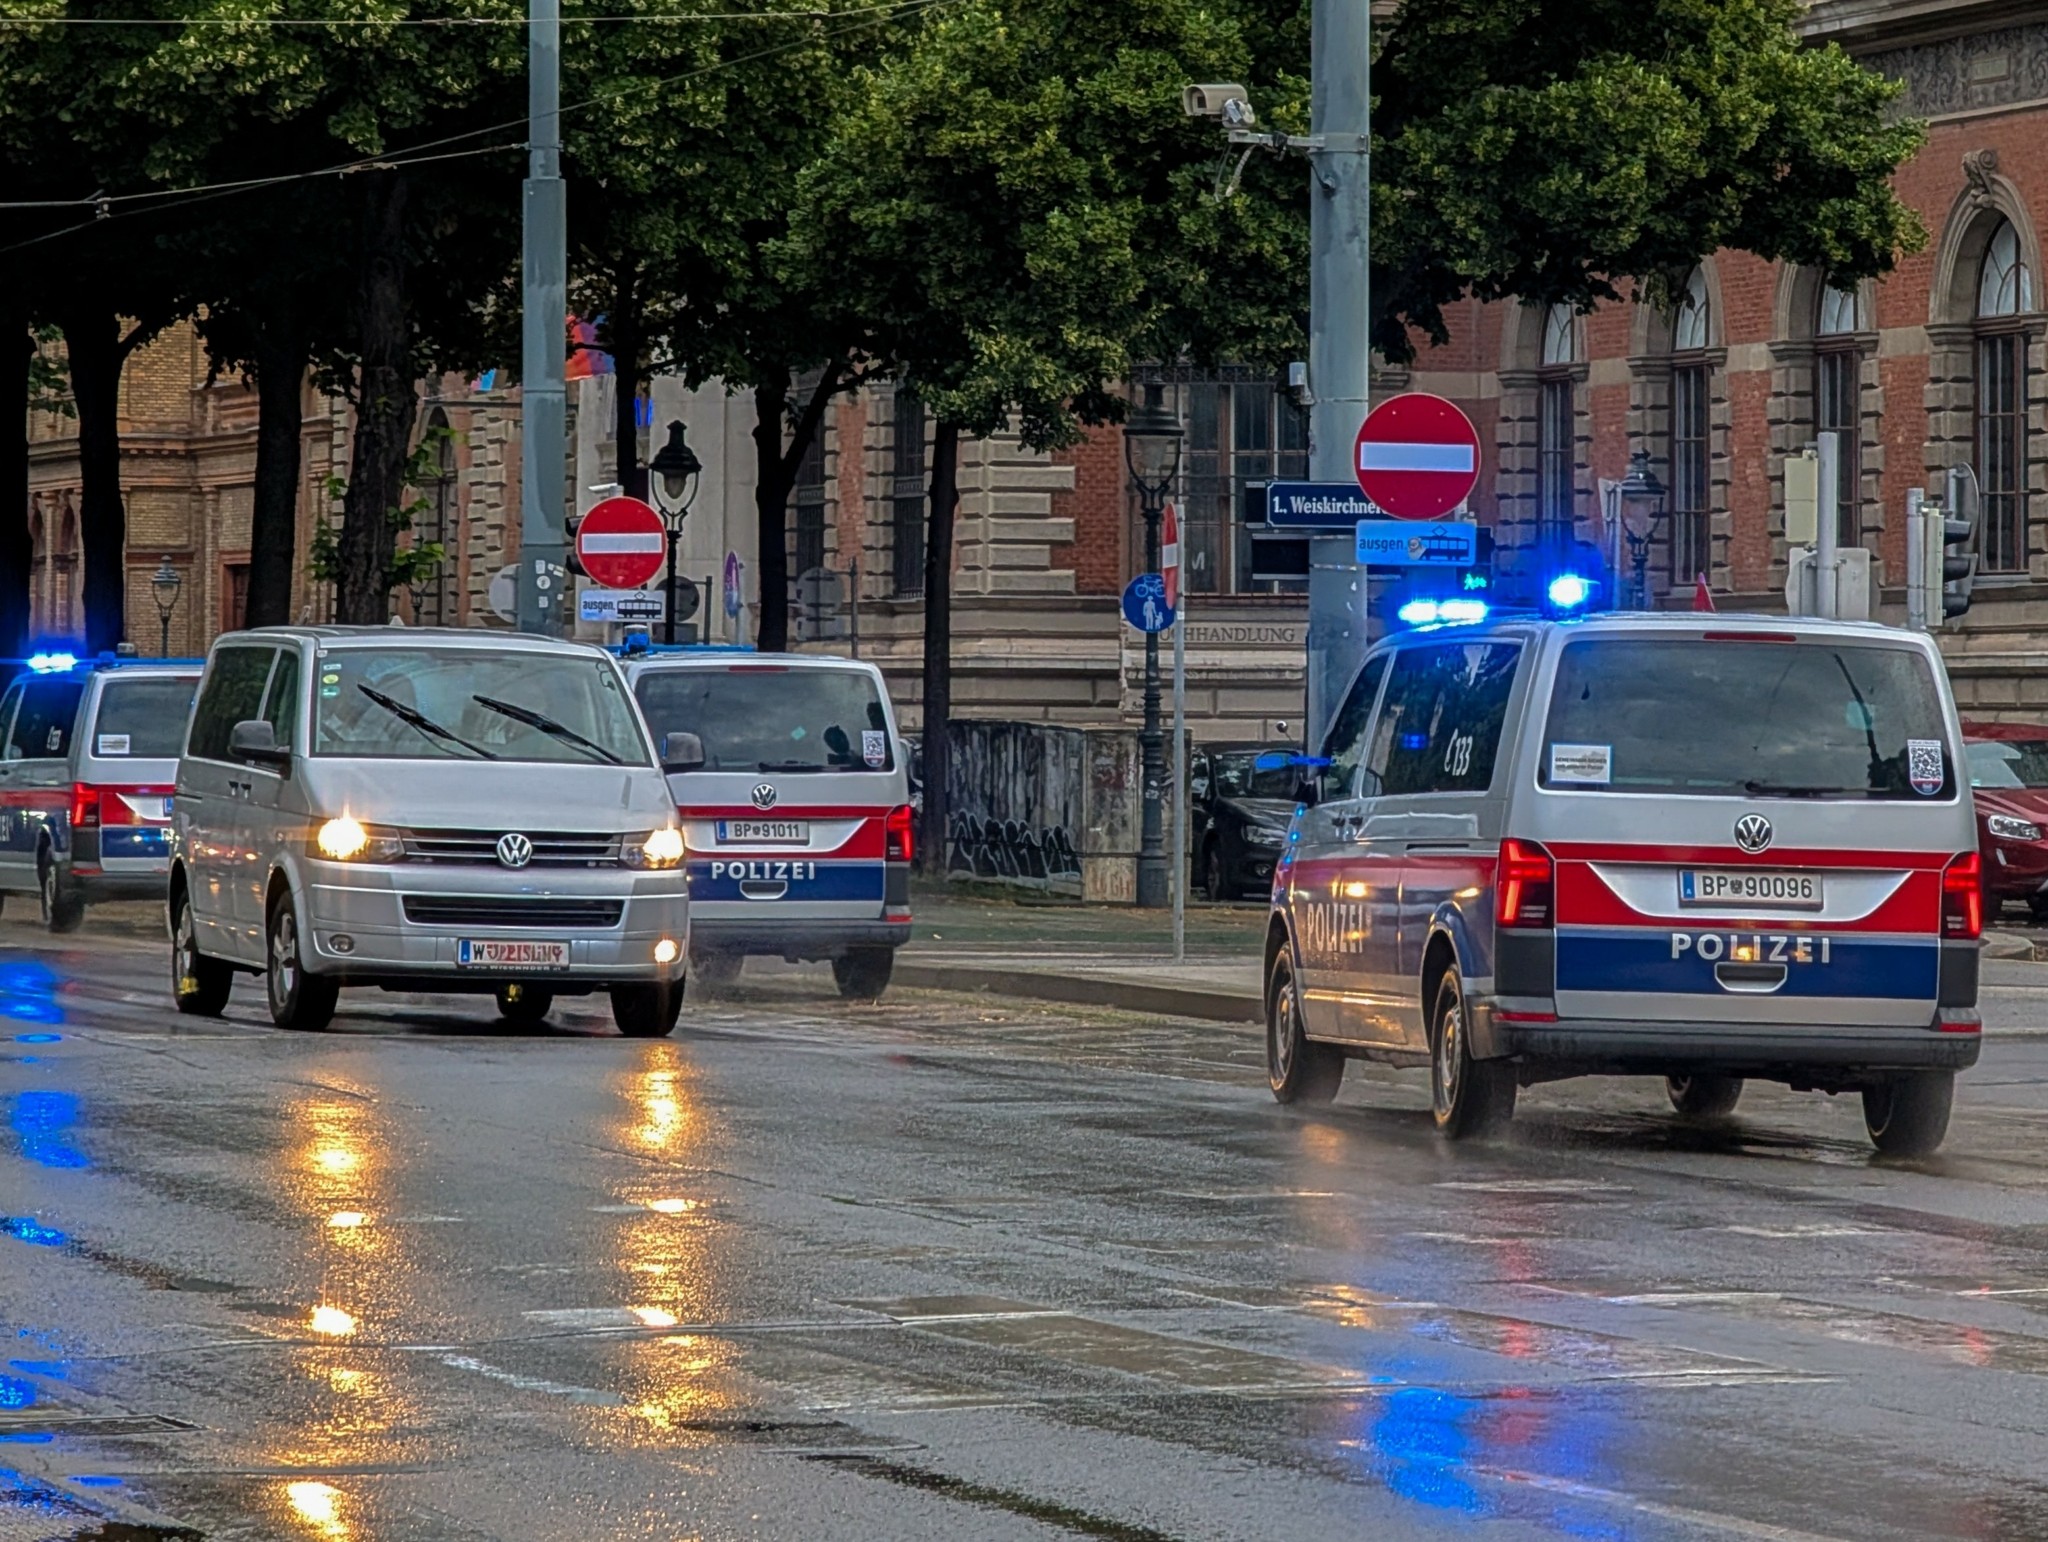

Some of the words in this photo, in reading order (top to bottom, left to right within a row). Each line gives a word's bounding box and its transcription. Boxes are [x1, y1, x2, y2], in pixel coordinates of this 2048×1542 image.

[712, 862, 815, 880] POLIZEI
[1307, 902, 1363, 954] POLIZEI
[1671, 932, 1830, 964] POLIZEI
